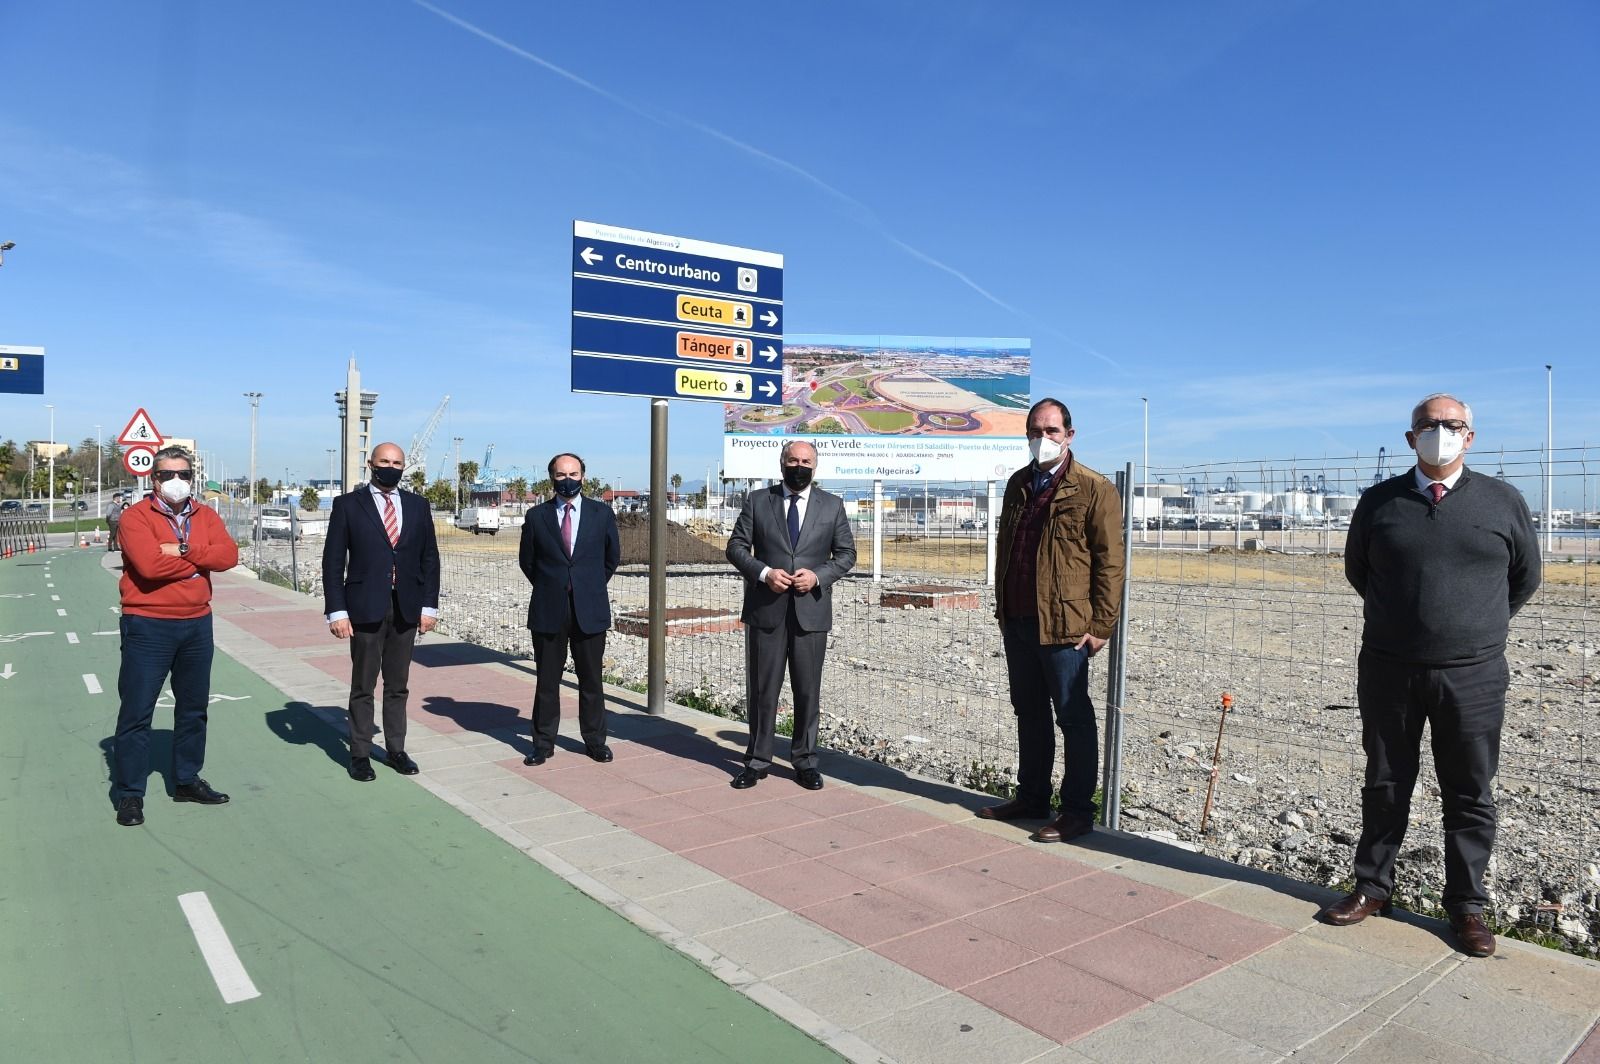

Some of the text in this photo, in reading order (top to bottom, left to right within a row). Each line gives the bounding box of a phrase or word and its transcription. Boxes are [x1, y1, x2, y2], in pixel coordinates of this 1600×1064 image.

[646, 237, 675, 248] Algeciras
[615, 254, 721, 283] Centro urbano
[681, 301, 723, 319] Ceuta
[681, 337, 731, 357] Tánger
[681, 375, 728, 392] Puerto
[732, 438, 779, 450] Proyecto
[831, 439, 862, 449] Verde
[924, 442, 954, 450] Saladillo
[959, 443, 981, 451] Puerto
[982, 443, 991, 451] de
[991, 443, 1023, 452] Algeciras
[131, 455, 151, 466] 30
[835, 466, 914, 476] Puerto de Algeciras
